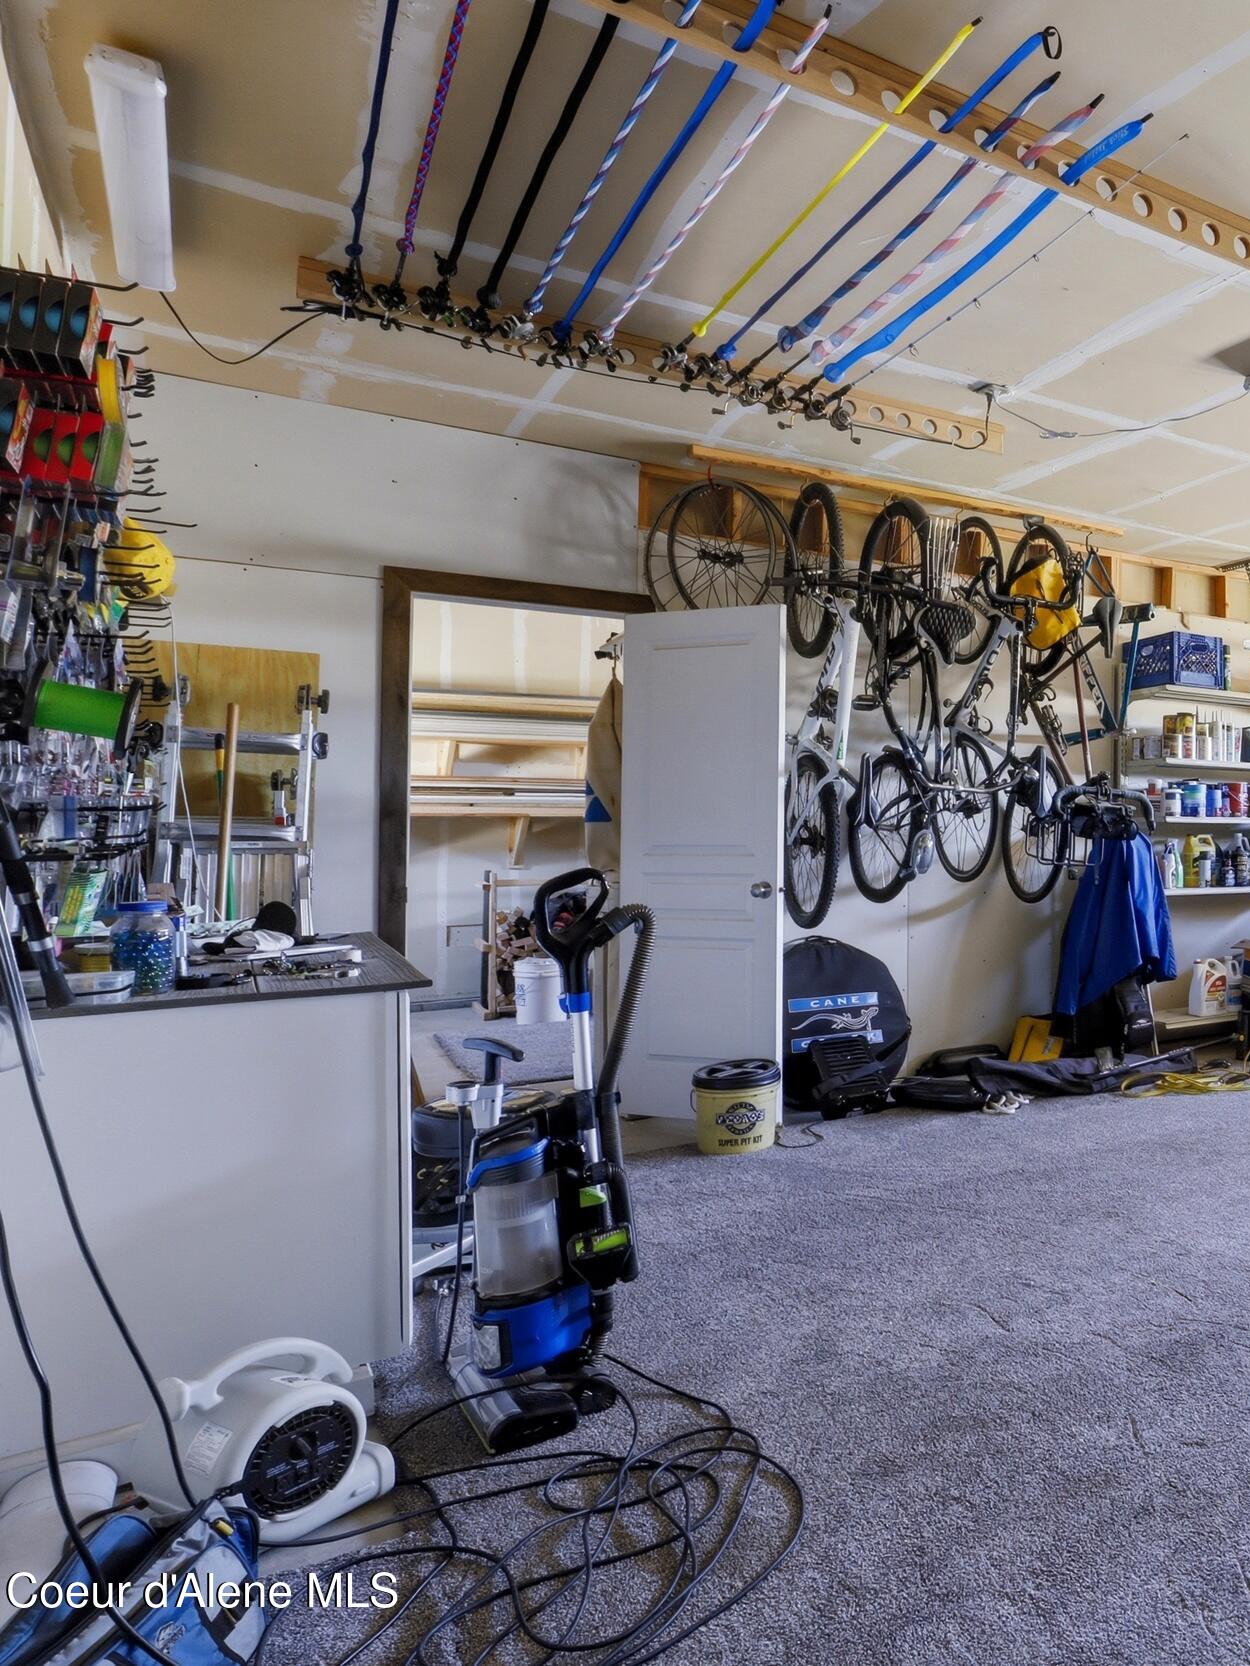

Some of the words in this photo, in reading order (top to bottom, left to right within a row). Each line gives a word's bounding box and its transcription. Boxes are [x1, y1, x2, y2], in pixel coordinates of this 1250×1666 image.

[810, 995, 860, 1008] CANE
[718, 1138, 739, 1147] SUPER
[740, 1137, 751, 1146] PIT
[752, 1134, 763, 1144] KIT
